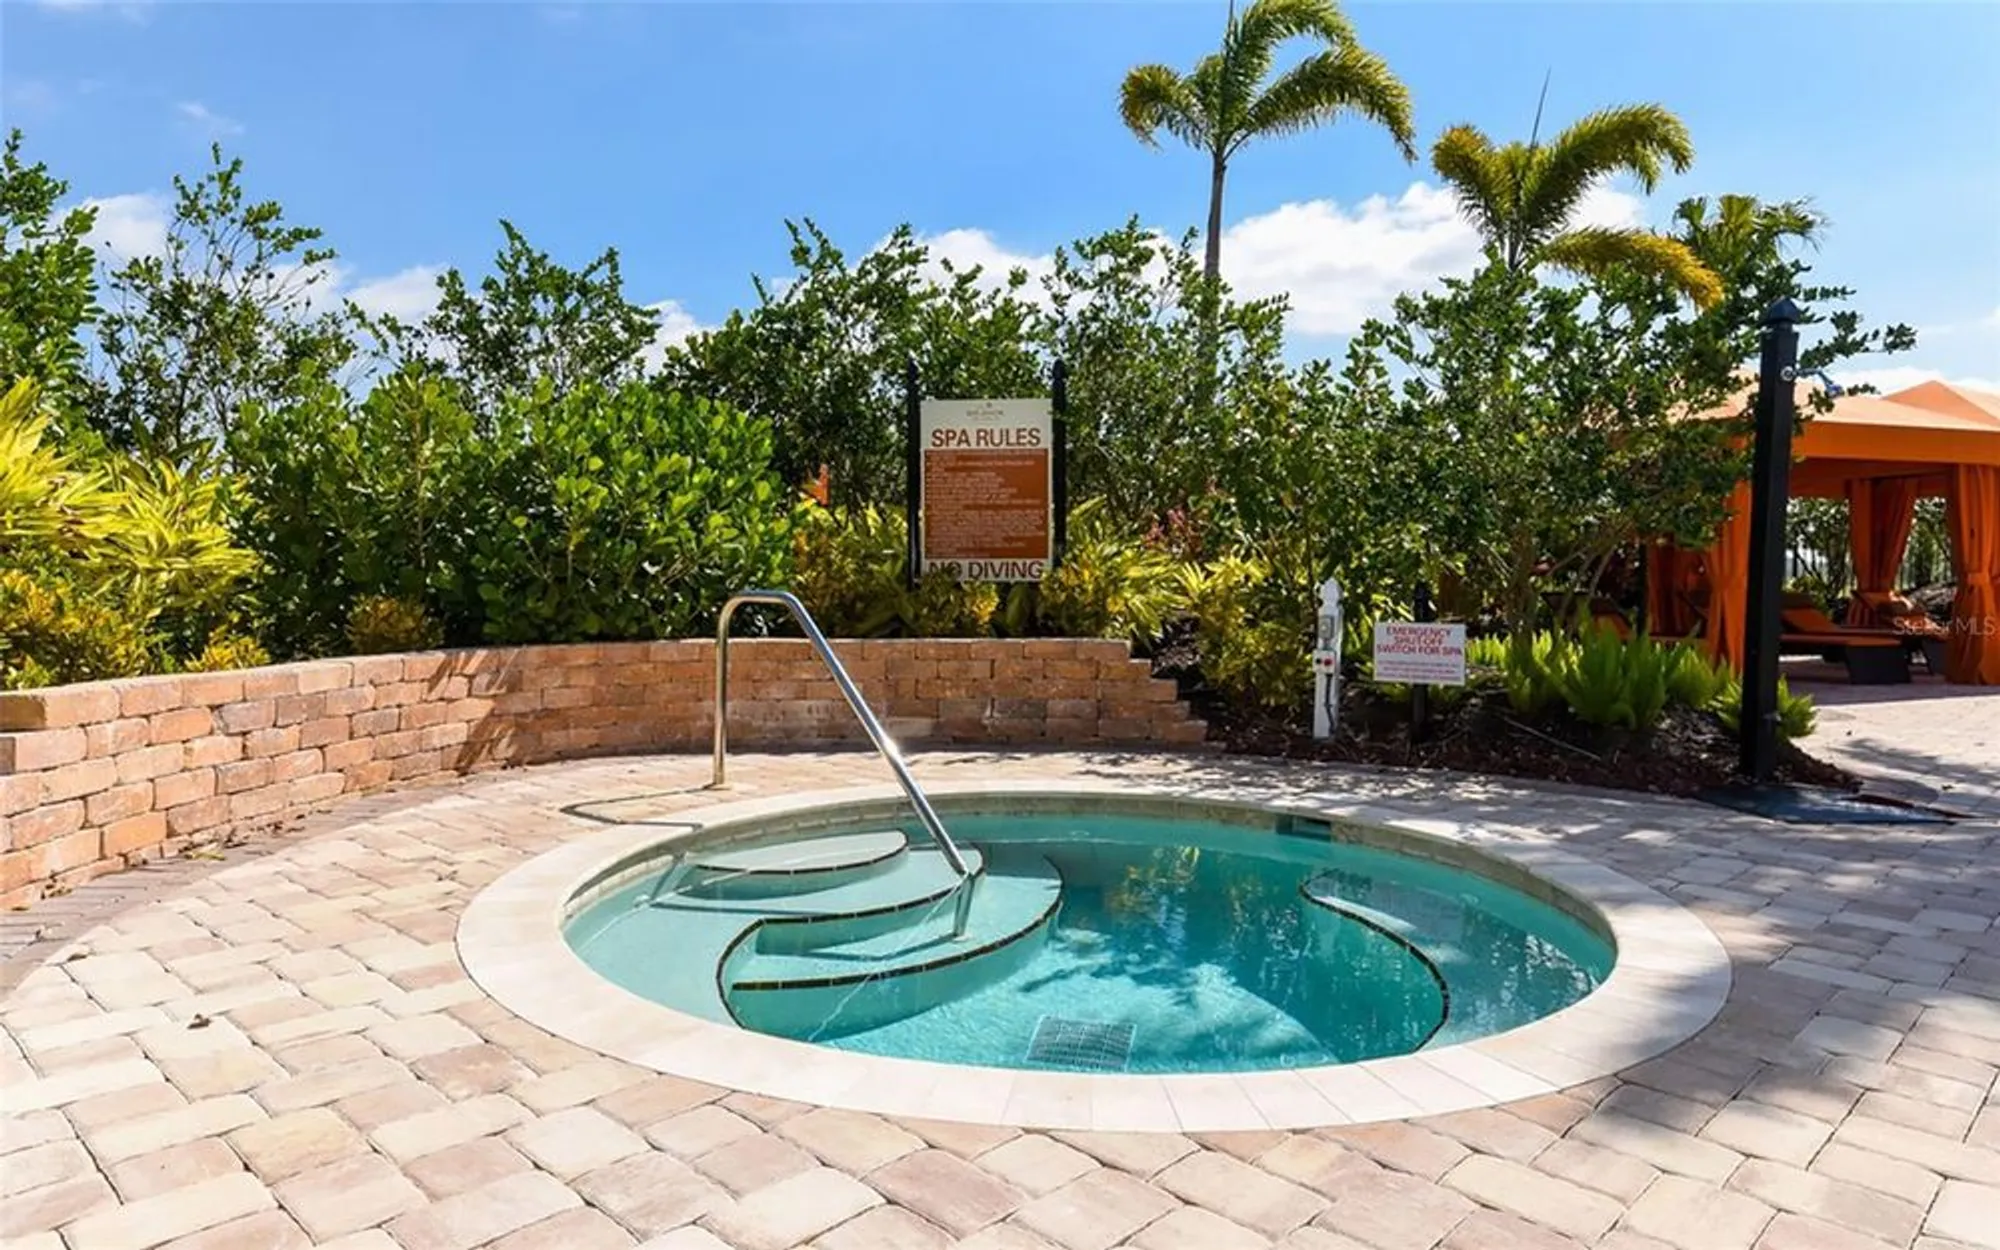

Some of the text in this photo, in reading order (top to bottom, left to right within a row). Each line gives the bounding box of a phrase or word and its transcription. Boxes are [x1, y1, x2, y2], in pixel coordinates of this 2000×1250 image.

[931, 428, 1041, 447] SPA RULES
[968, 560, 1045, 579] DIVING
[1386, 626, 1451, 637] EMERGENCY
[1418, 645, 1440, 655] FOR
